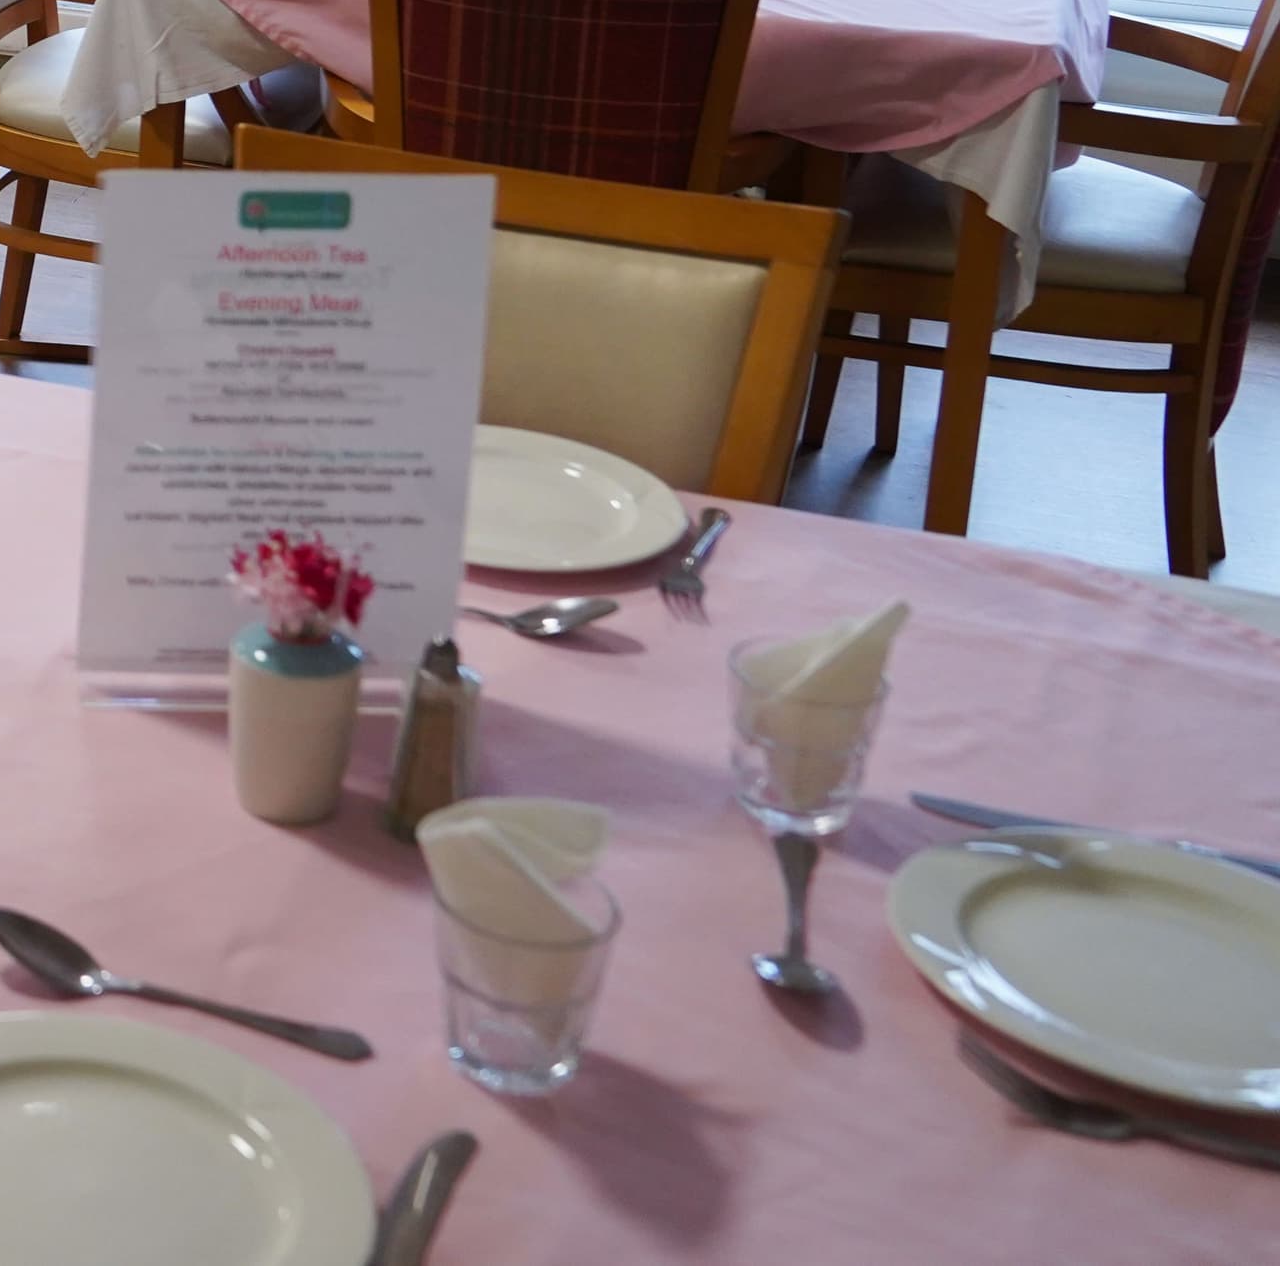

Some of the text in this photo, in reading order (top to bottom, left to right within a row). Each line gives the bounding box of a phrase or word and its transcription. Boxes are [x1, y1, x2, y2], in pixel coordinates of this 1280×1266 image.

[216, 244, 368, 264] Afternoon Tea
[217, 291, 303, 315] Evening
